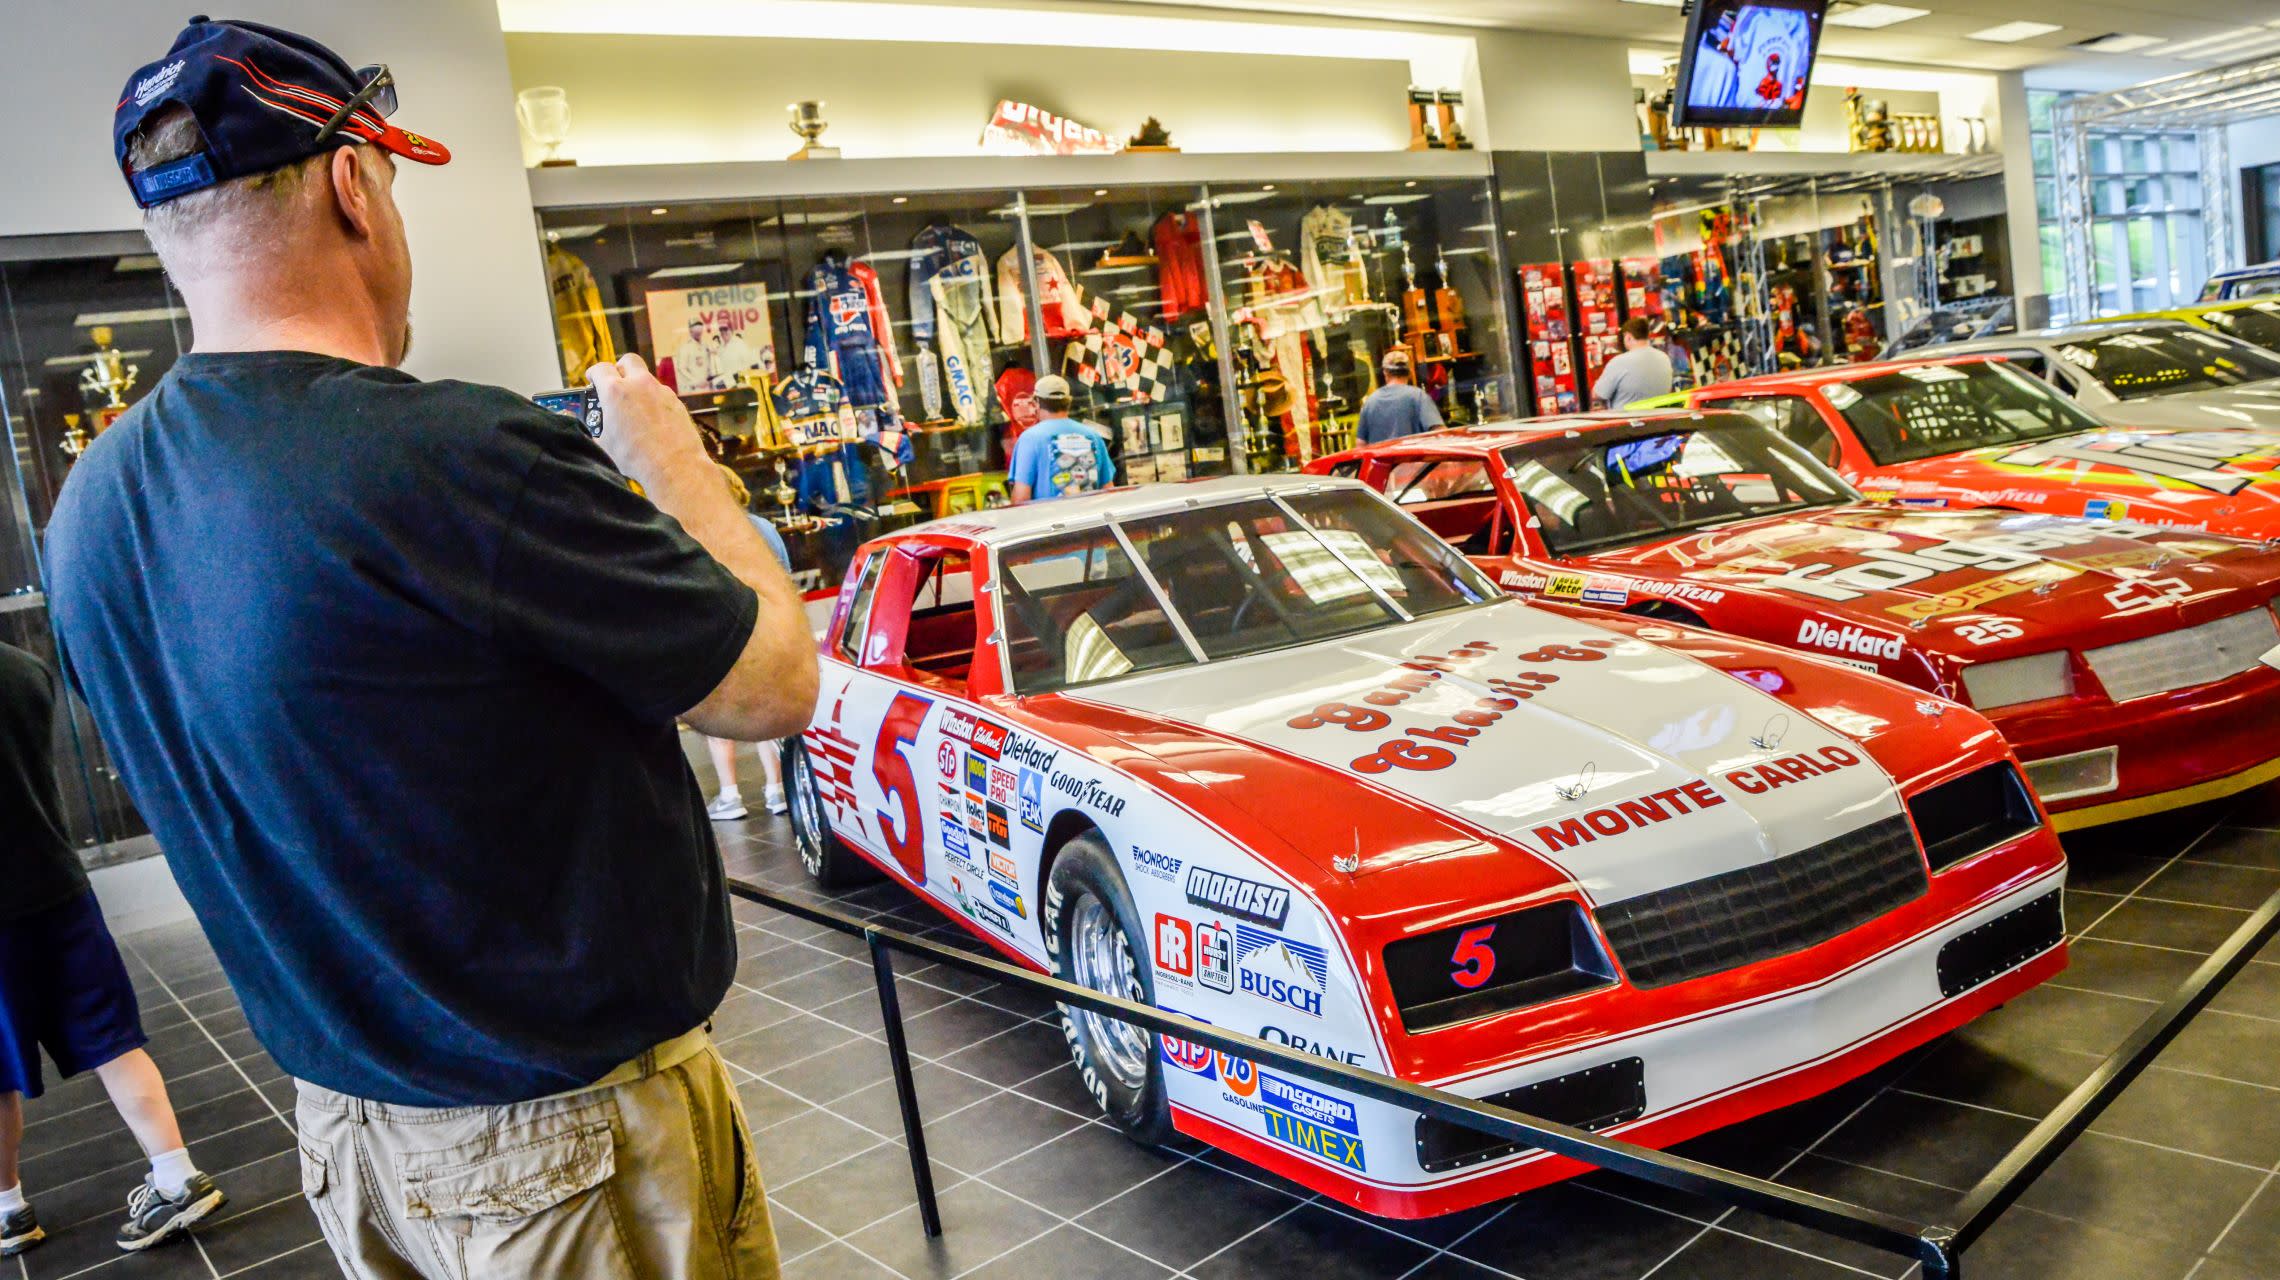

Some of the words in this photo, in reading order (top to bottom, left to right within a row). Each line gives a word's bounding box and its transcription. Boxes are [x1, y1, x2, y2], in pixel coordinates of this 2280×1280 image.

[134, 59, 187, 99] Hendrick
[687, 286, 757, 307] mello
[946, 355, 973, 407] GMAC
[1499, 570, 1547, 590] Winston
[1631, 579, 1727, 604] GOODYEAR
[1796, 618, 1905, 661] DieHard
[1953, 615, 2024, 647] 25
[940, 709, 975, 741] Winston
[1350, 671, 1561, 774] Chassis
[938, 743, 956, 777] STP
[1003, 731, 1059, 775] DieHard
[872, 689, 936, 888] 5
[990, 769, 1016, 791] SPEED
[990, 785, 1007, 804] PRO
[1050, 770, 1127, 818] GOODYEAR
[1020, 797, 1044, 827] PEAK
[1531, 778, 1727, 853] MONTE
[1725, 744, 1862, 795] CARLO
[944, 850, 966, 869] PERFECT
[966, 862, 985, 880] CIRCLE
[1135, 861, 1150, 876] SHOCK
[1136, 848, 1177, 874] MONROE
[1186, 868, 1290, 921] MOROSO
[1450, 922, 1497, 989] 5
[1203, 969, 1228, 984] SHIFTERS
[1240, 966, 1323, 1019] BUSCH
[1222, 1091, 1265, 1115] GASOLINE
[1291, 1102, 1336, 1124] GASKETS
[1264, 1108, 1362, 1169] TIMEX
